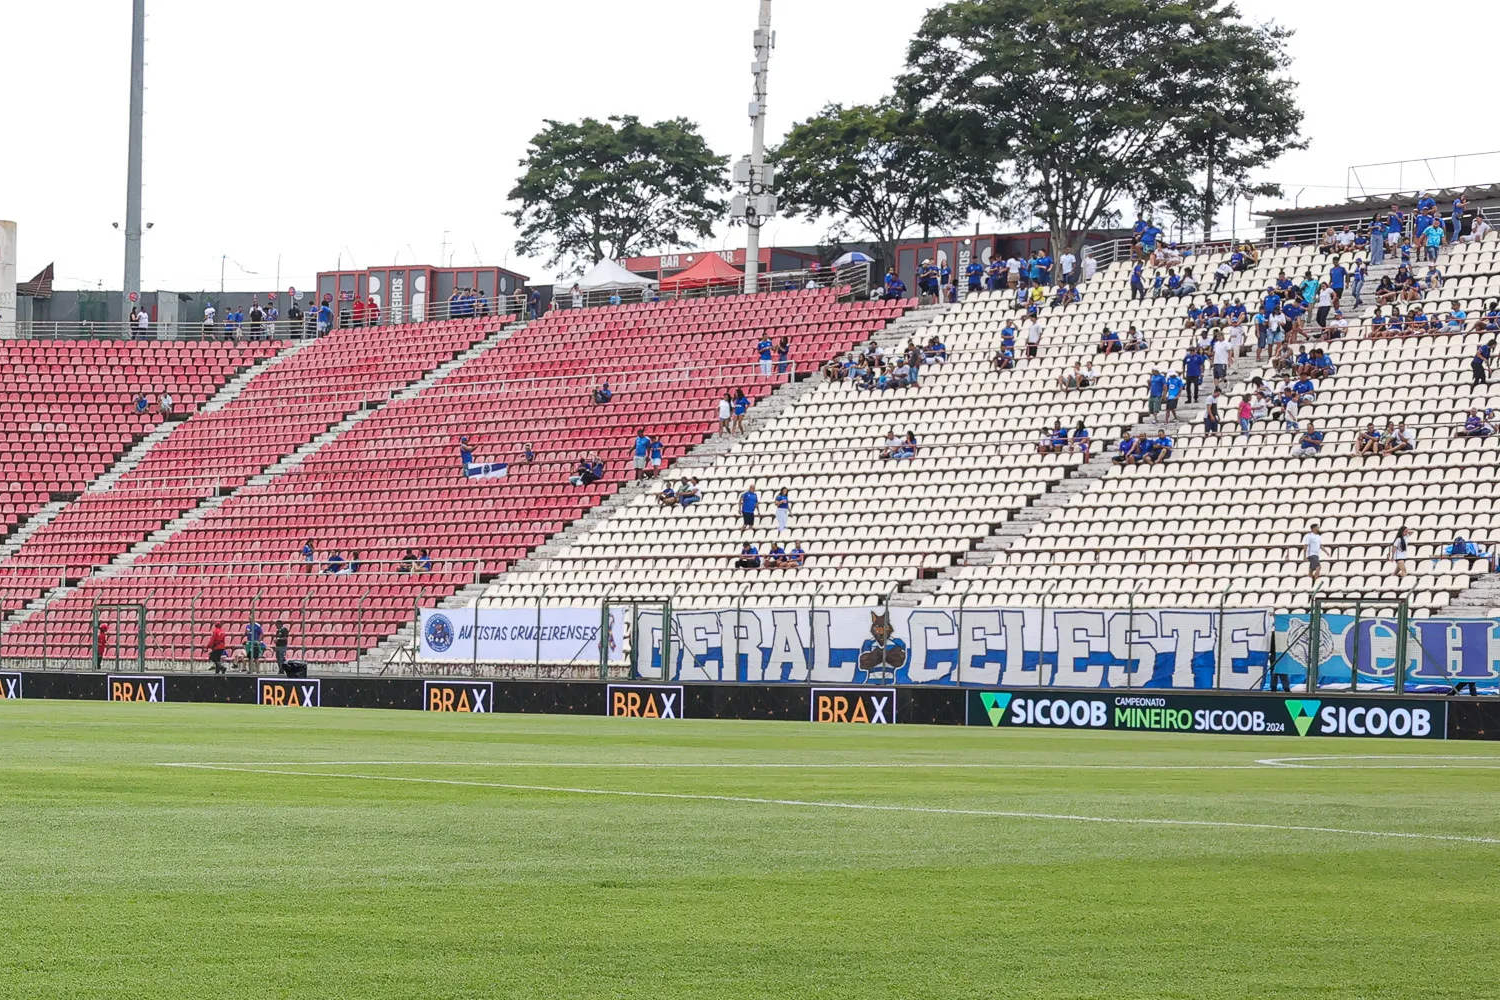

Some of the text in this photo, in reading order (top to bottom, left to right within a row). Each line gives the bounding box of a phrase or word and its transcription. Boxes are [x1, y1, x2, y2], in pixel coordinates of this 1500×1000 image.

[660, 255, 679, 268] BAR
[458, 624, 598, 641] AUTISTAS CRUZEIRENSES
[636, 609, 1271, 690] GERAL CELESTE
[112, 682, 159, 703] BRAX
[263, 684, 316, 707] BRAX
[430, 688, 486, 713] BRAX
[1114, 697, 1166, 707] CAMPEONATO
[613, 692, 678, 719] BRAX
[818, 696, 889, 724] BRAX
[1011, 699, 1107, 727] SICOOB
[1114, 708, 1285, 733] MINEIRO SICOOB 2024
[1320, 706, 1431, 736] SICOOB
